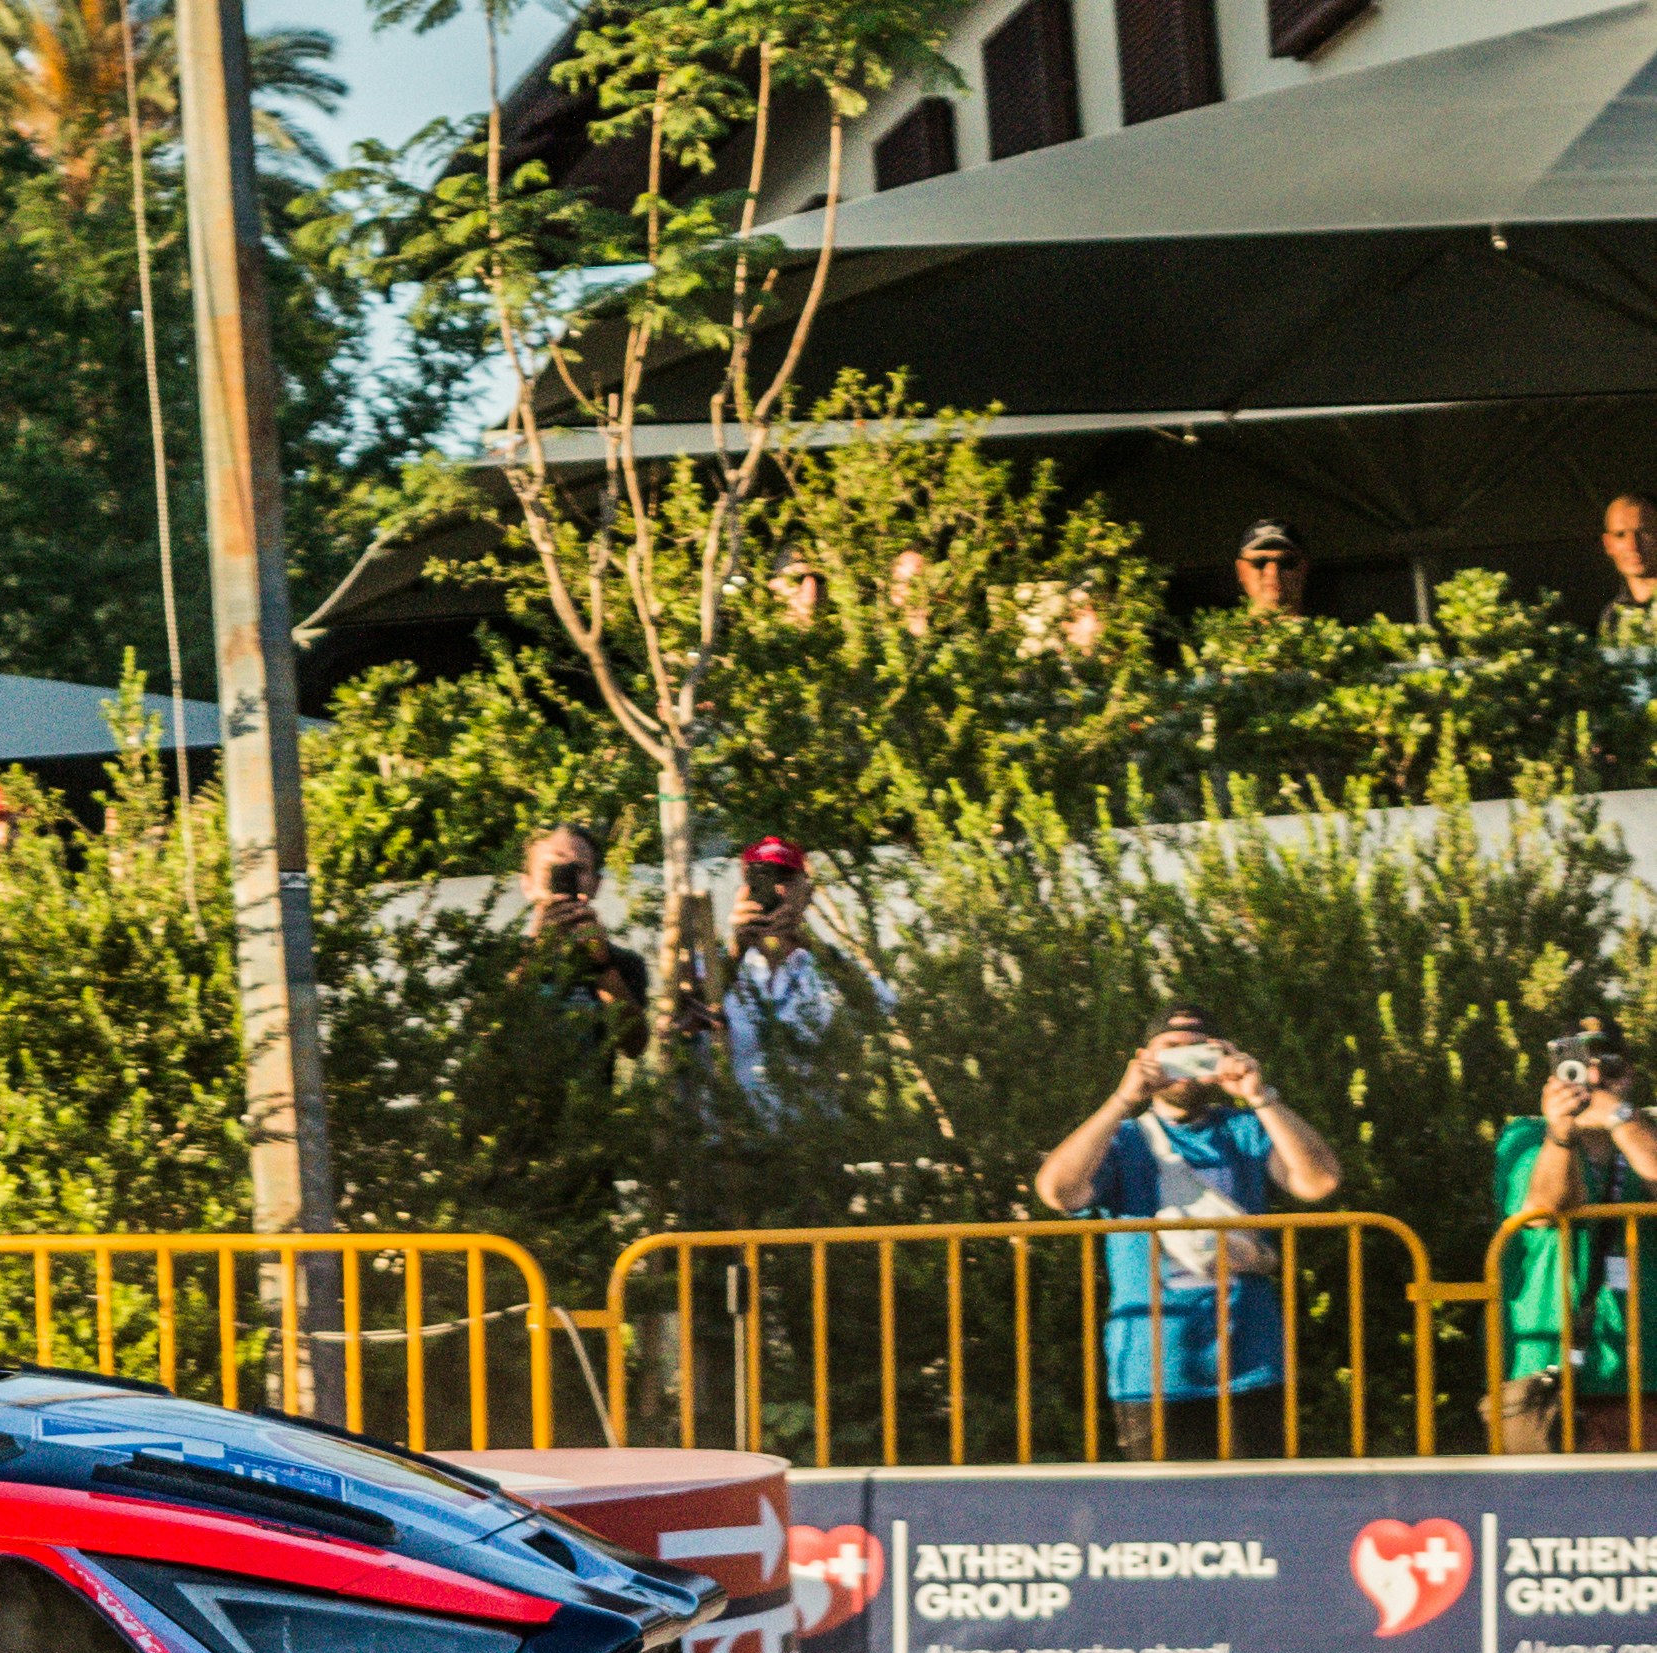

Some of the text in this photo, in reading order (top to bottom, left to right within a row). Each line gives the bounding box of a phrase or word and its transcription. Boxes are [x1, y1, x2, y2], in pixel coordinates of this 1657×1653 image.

[913, 1540, 1279, 1580] ATHENS MEDICAL
[915, 1582, 1072, 1622] GROUP
[1504, 1577, 1657, 1617] GROUP
